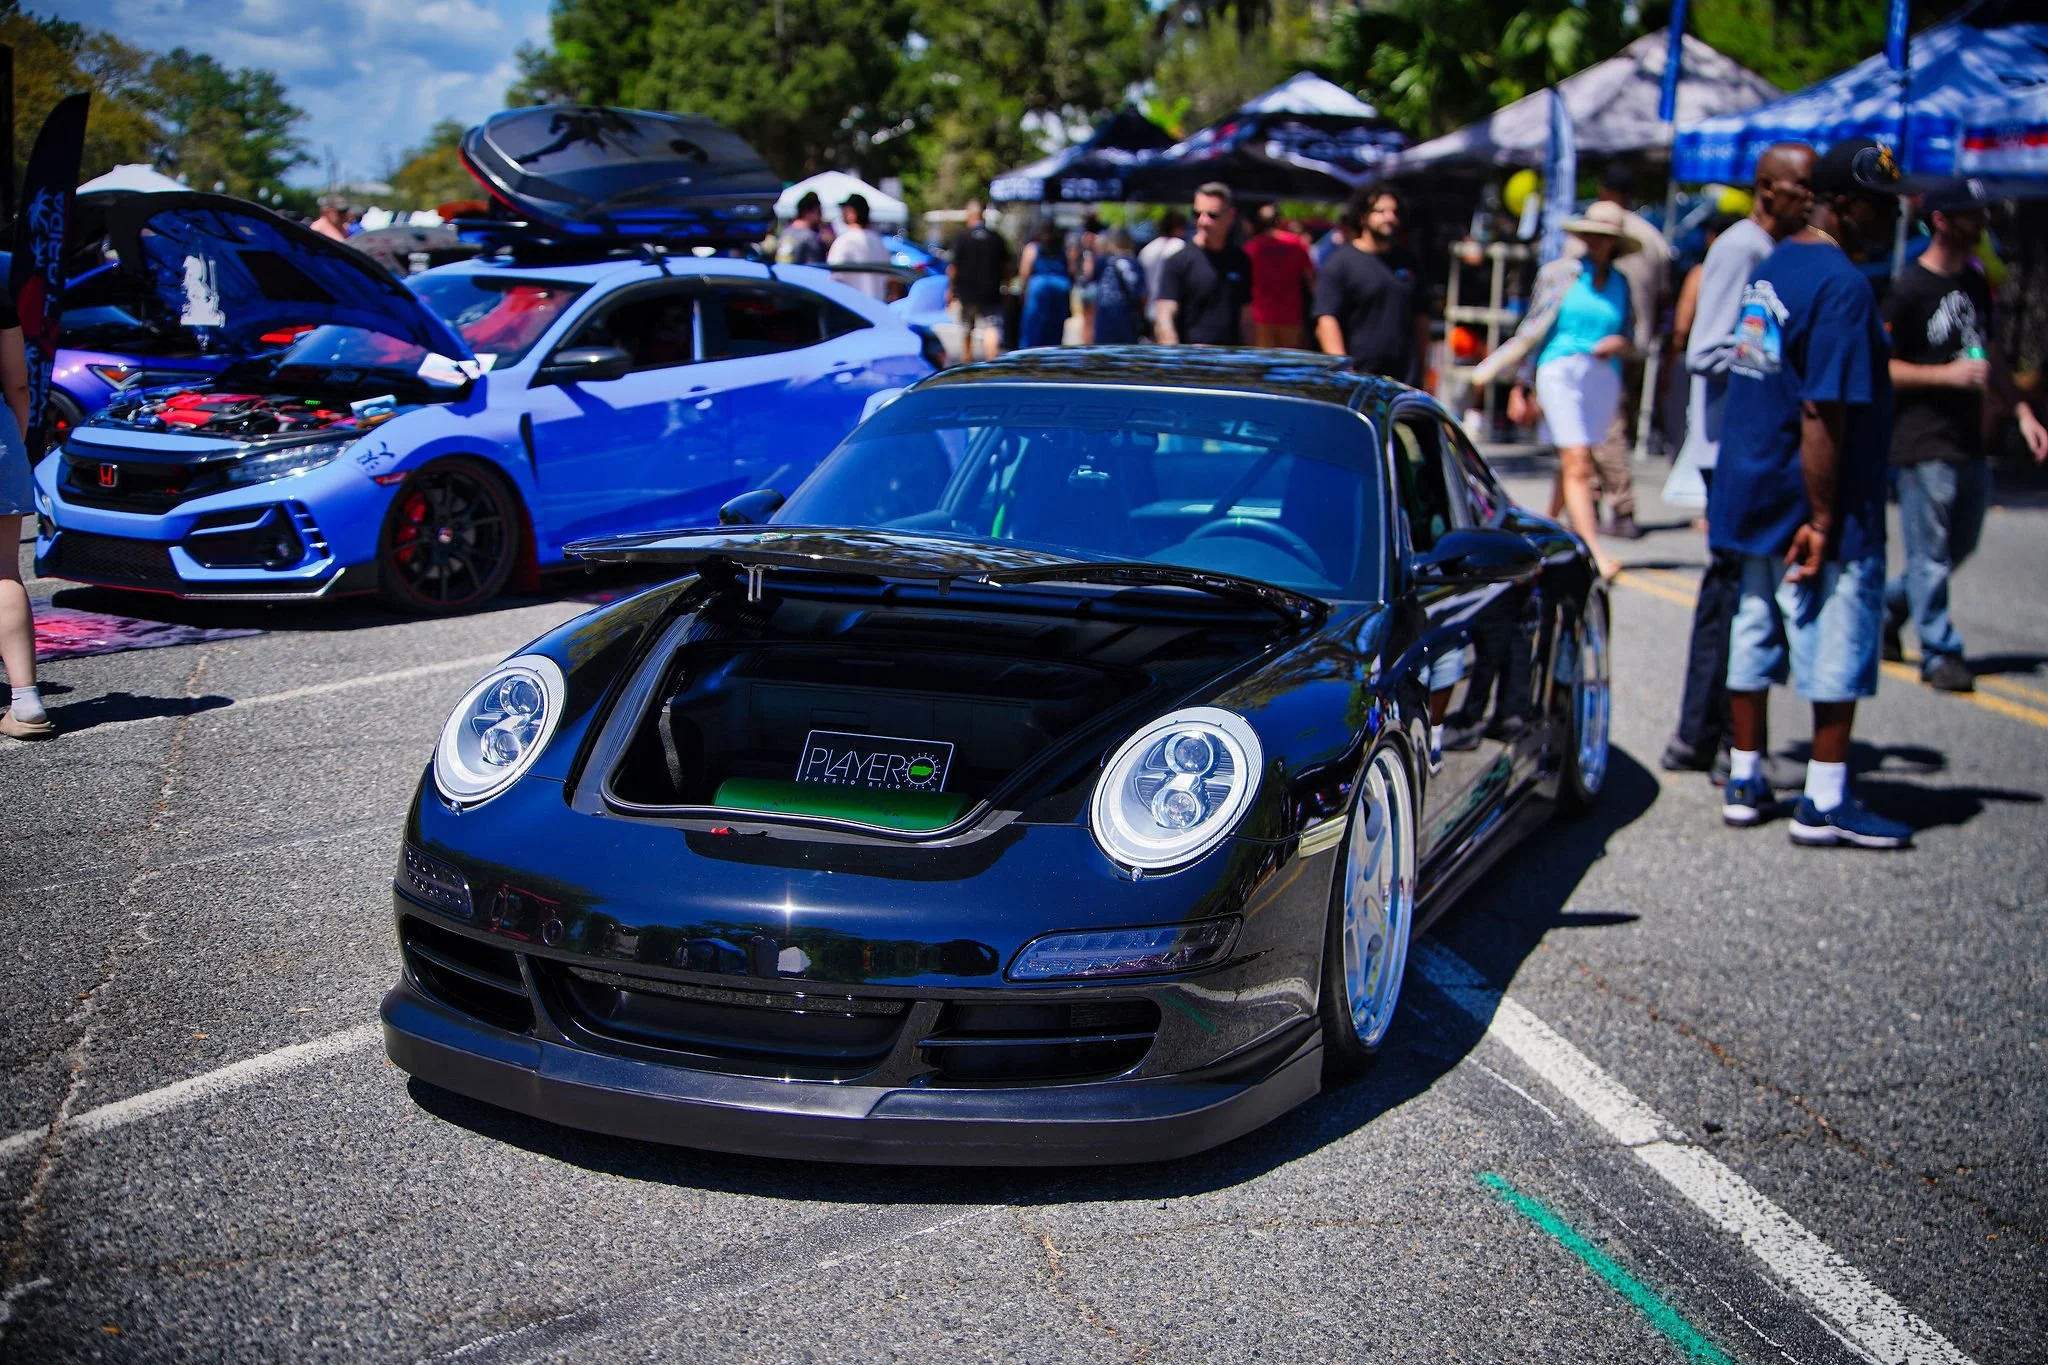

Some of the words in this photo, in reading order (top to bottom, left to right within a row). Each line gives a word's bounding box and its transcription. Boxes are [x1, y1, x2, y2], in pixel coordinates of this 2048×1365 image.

[916, 403, 1282, 444] PORSCE
[804, 775, 856, 785] PUERTO
[868, 781, 901, 790] RICO
